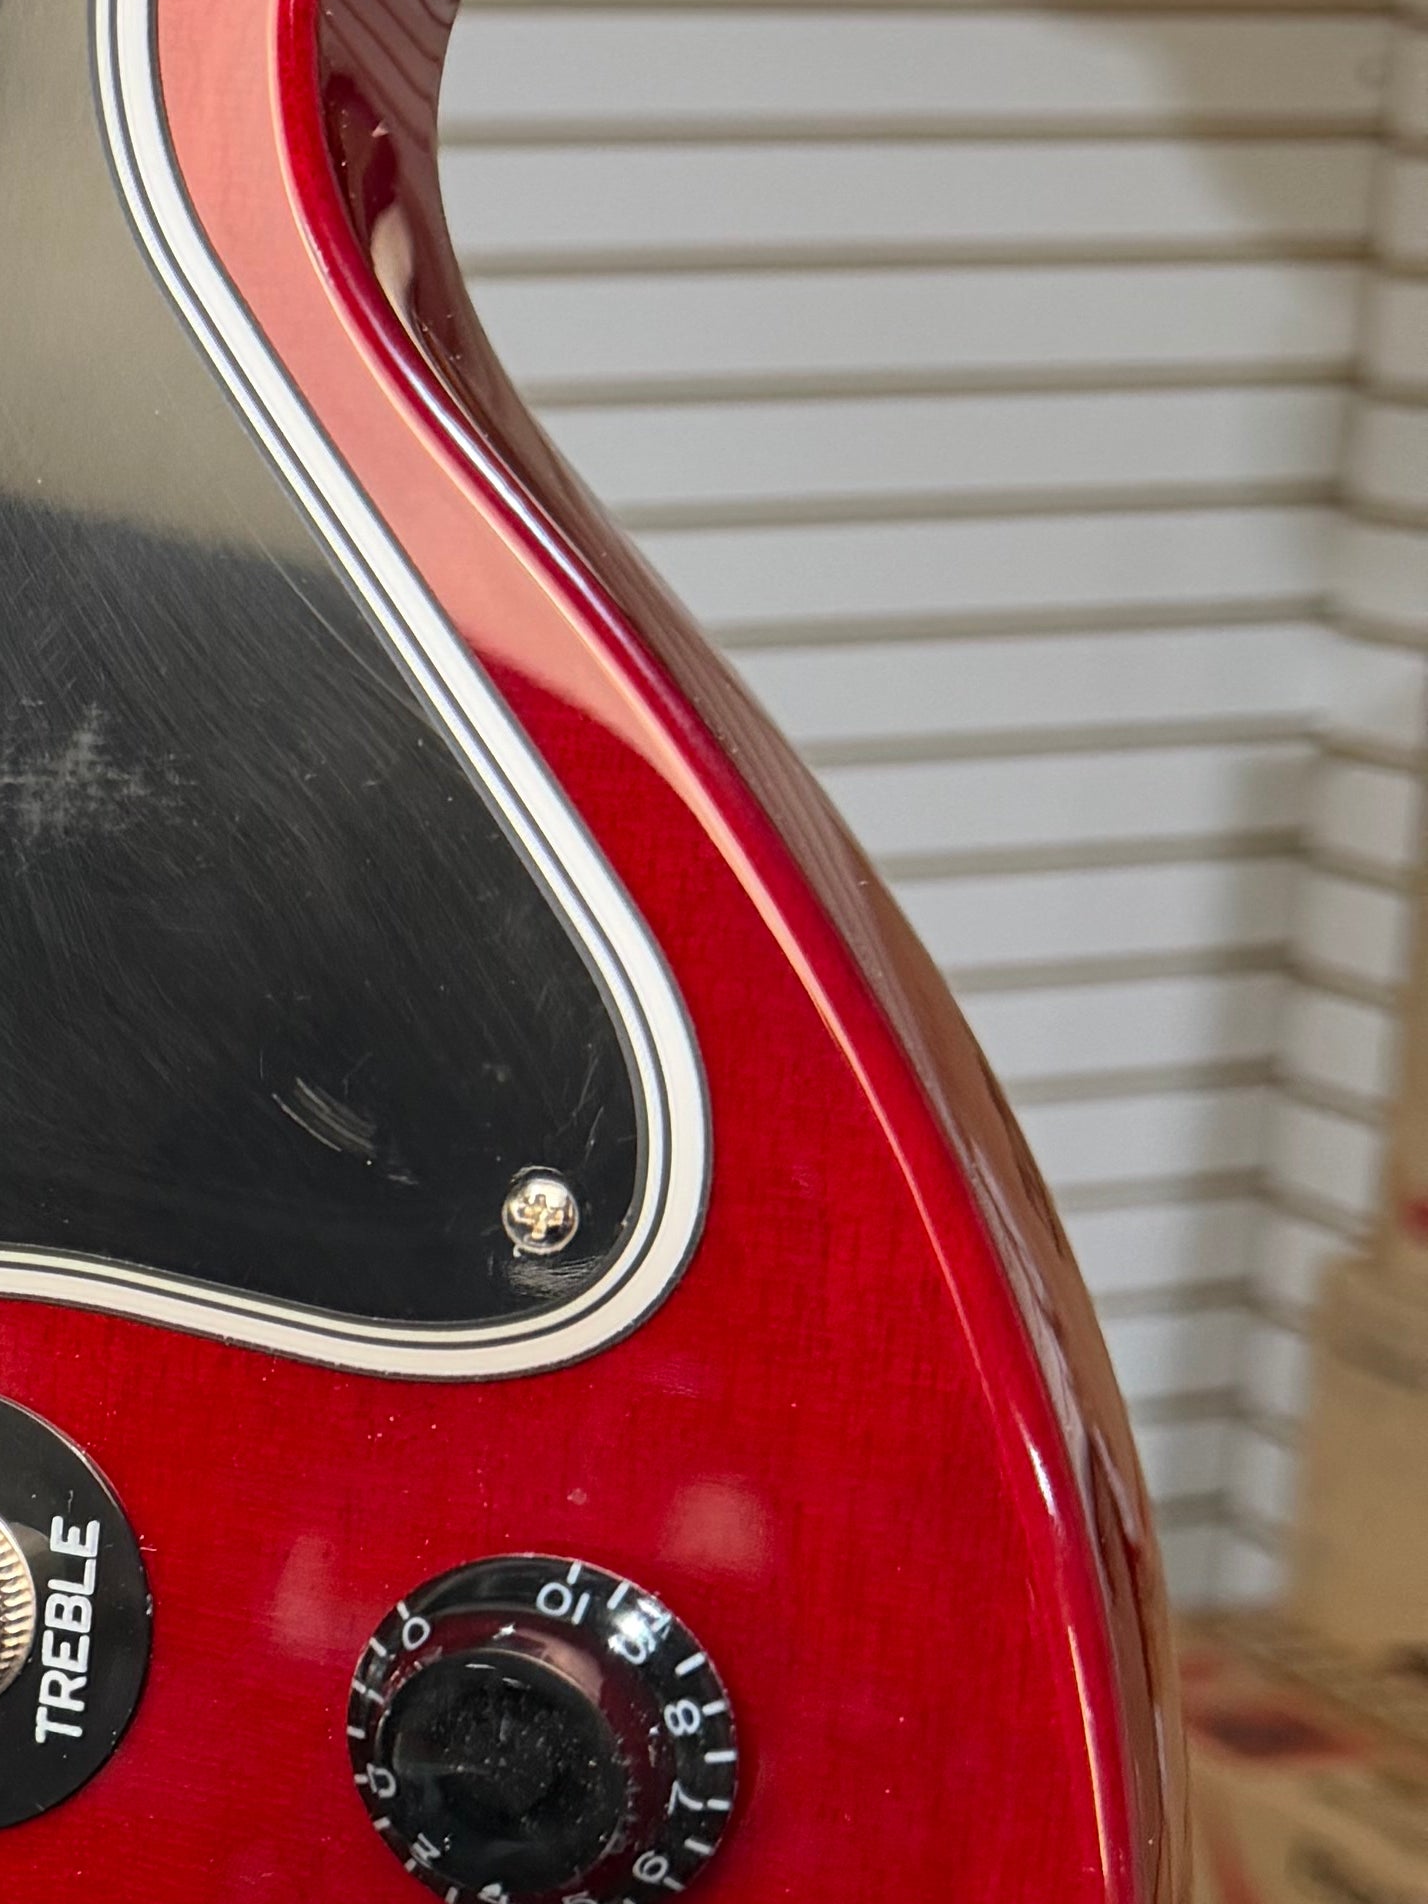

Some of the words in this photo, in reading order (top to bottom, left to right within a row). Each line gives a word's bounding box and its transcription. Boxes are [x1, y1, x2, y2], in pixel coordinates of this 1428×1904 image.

[35, 1515, 101, 1744] TREBLE
[401, 1616, 432, 1651] 0
[663, 1699, 701, 1737] 8
[667, 1780, 705, 1815] 7
